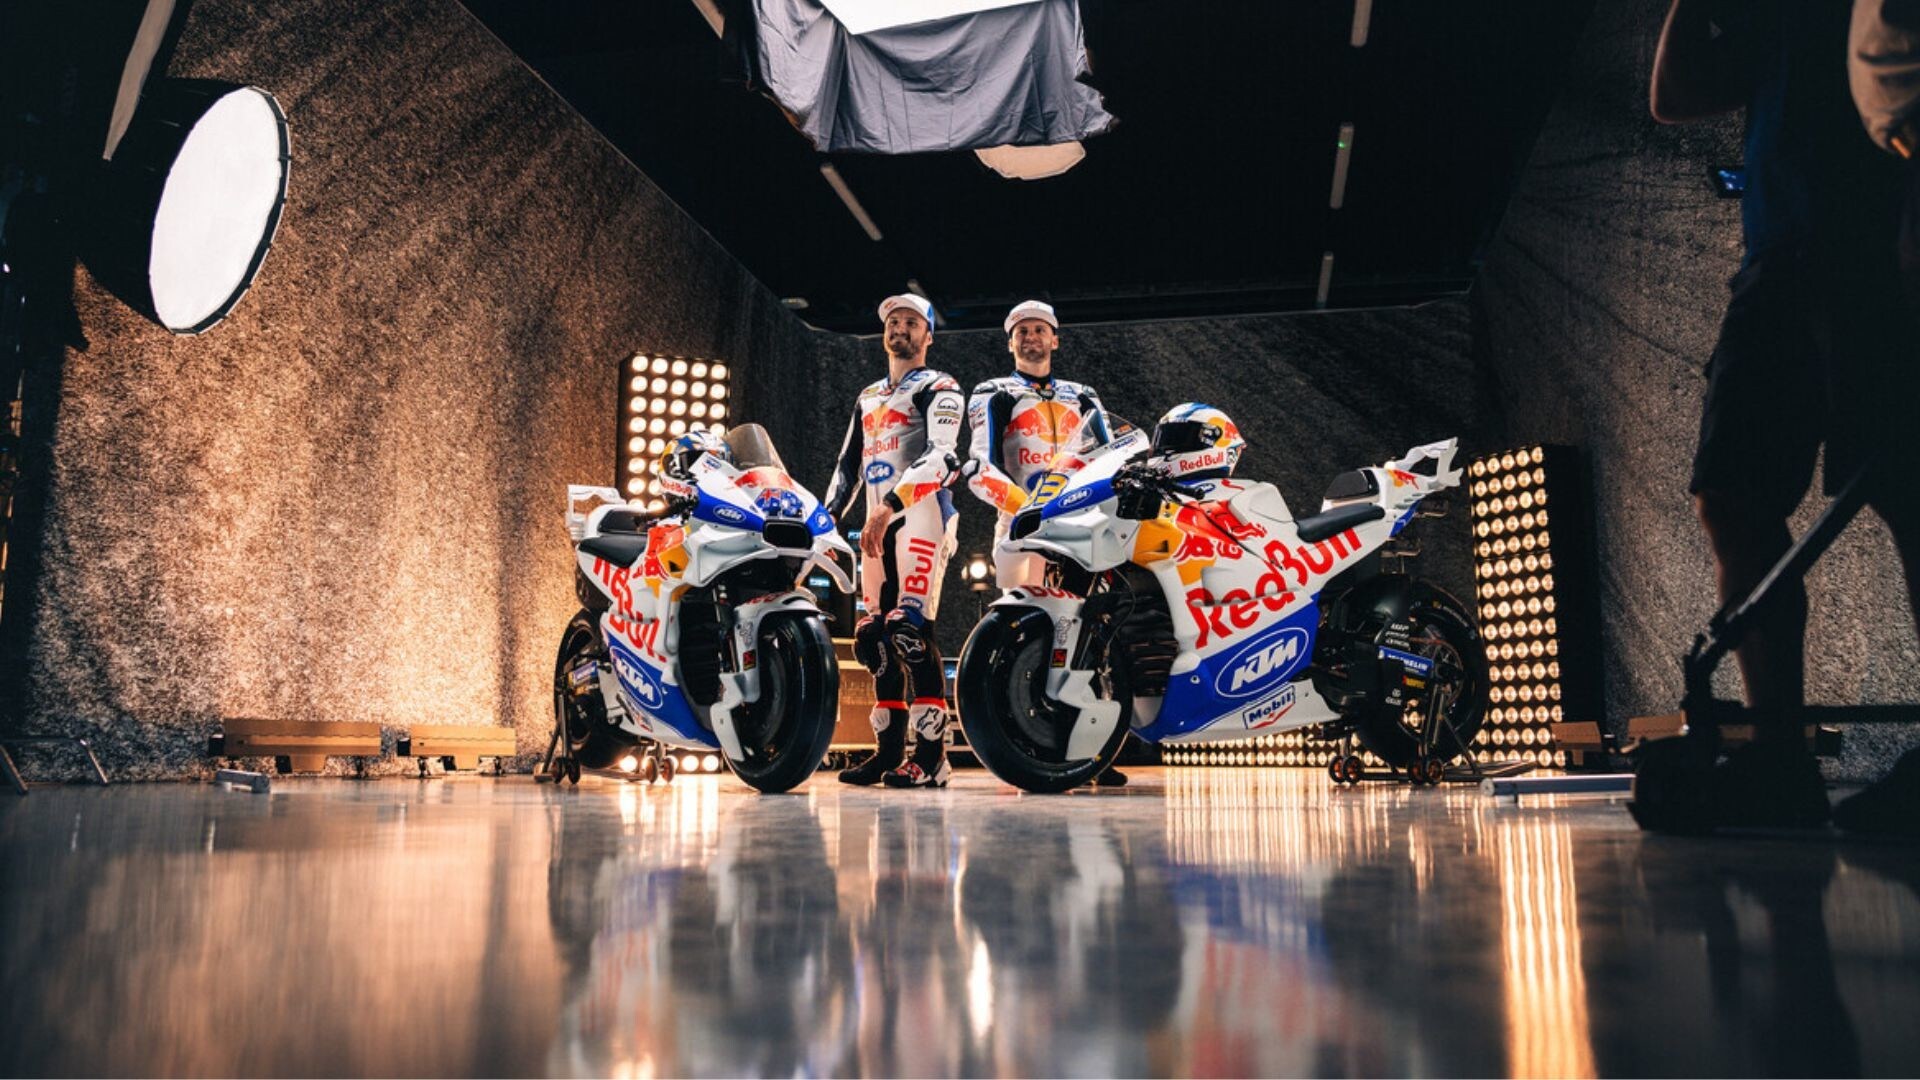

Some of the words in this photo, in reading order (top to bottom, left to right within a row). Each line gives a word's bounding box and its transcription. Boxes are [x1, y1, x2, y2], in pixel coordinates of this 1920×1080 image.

[875, 436, 898, 454] Bull
[1019, 448, 1054, 465] Red
[1180, 456, 1202, 472] Red
[1203, 451, 1224, 466] Bull
[1063, 490, 1088, 506] KTM
[717, 508, 742, 520] KTM
[905, 537, 936, 595] Bull
[1185, 559, 1296, 650] Red
[1263, 529, 1362, 587] Bull
[1231, 636, 1298, 691] KTM
[616, 657, 655, 702] KTM
[1249, 692, 1291, 722] Mobil
